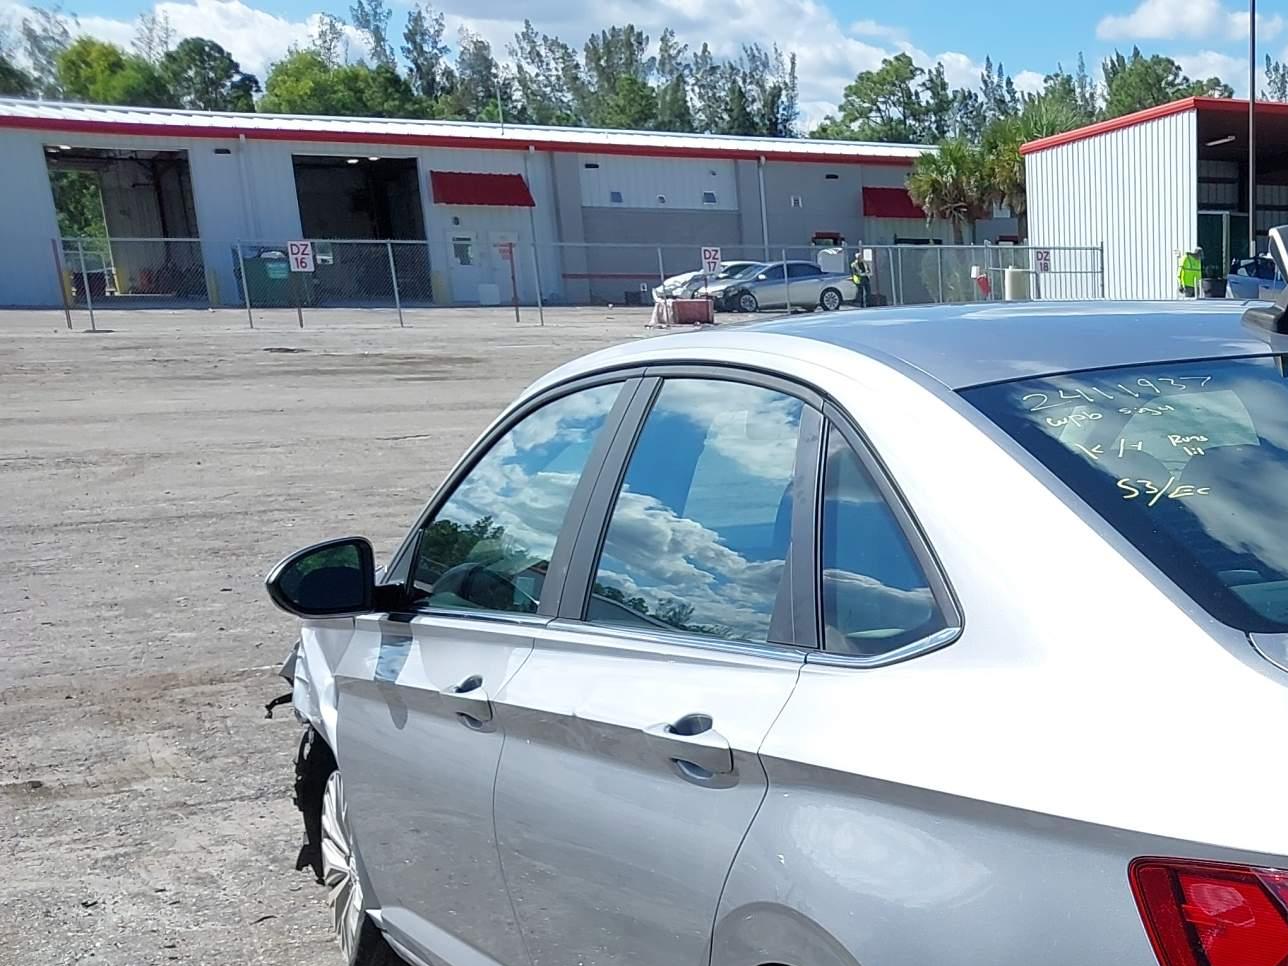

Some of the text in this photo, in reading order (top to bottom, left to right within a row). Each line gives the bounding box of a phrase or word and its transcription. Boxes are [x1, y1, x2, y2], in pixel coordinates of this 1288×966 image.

[290, 243, 310, 256] DZ
[703, 249, 719, 260] DZ
[1036, 251, 1051, 261] DZ
[295, 257, 308, 269] 16
[707, 261, 717, 272] 17
[1039, 262, 1048, 272] 18
